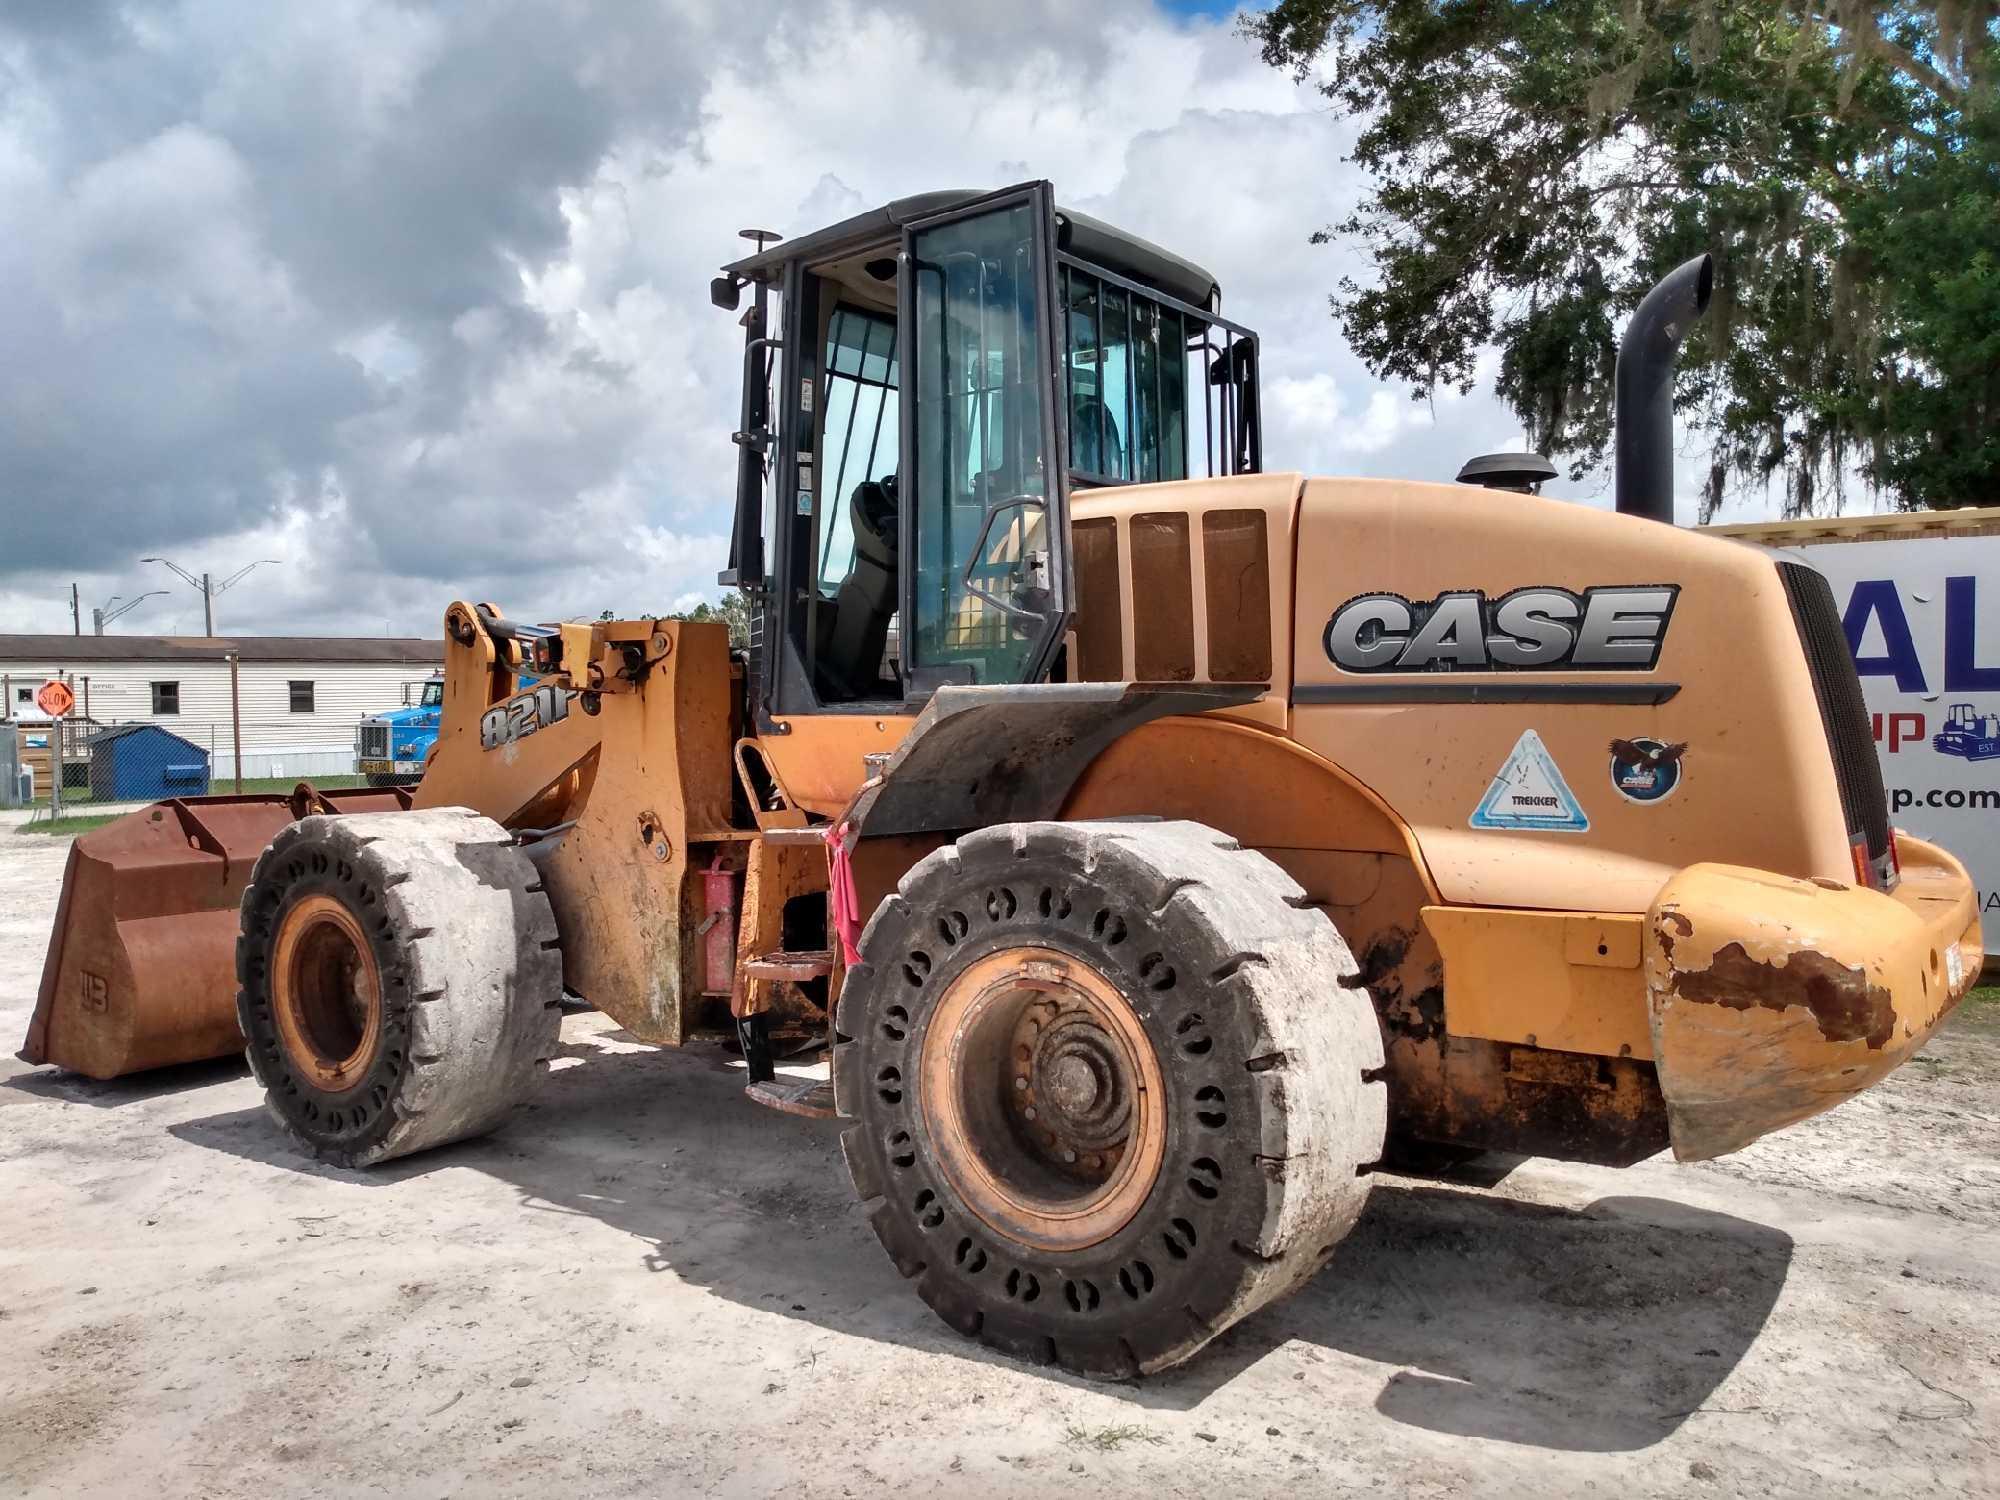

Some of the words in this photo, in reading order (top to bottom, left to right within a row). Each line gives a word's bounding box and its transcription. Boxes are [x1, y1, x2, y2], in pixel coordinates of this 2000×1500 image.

[1326, 587, 1677, 671] CASE
[42, 692, 68, 706] SLOW
[1511, 795, 1558, 809] TREKKER
[1885, 788, 2000, 813] p.com
